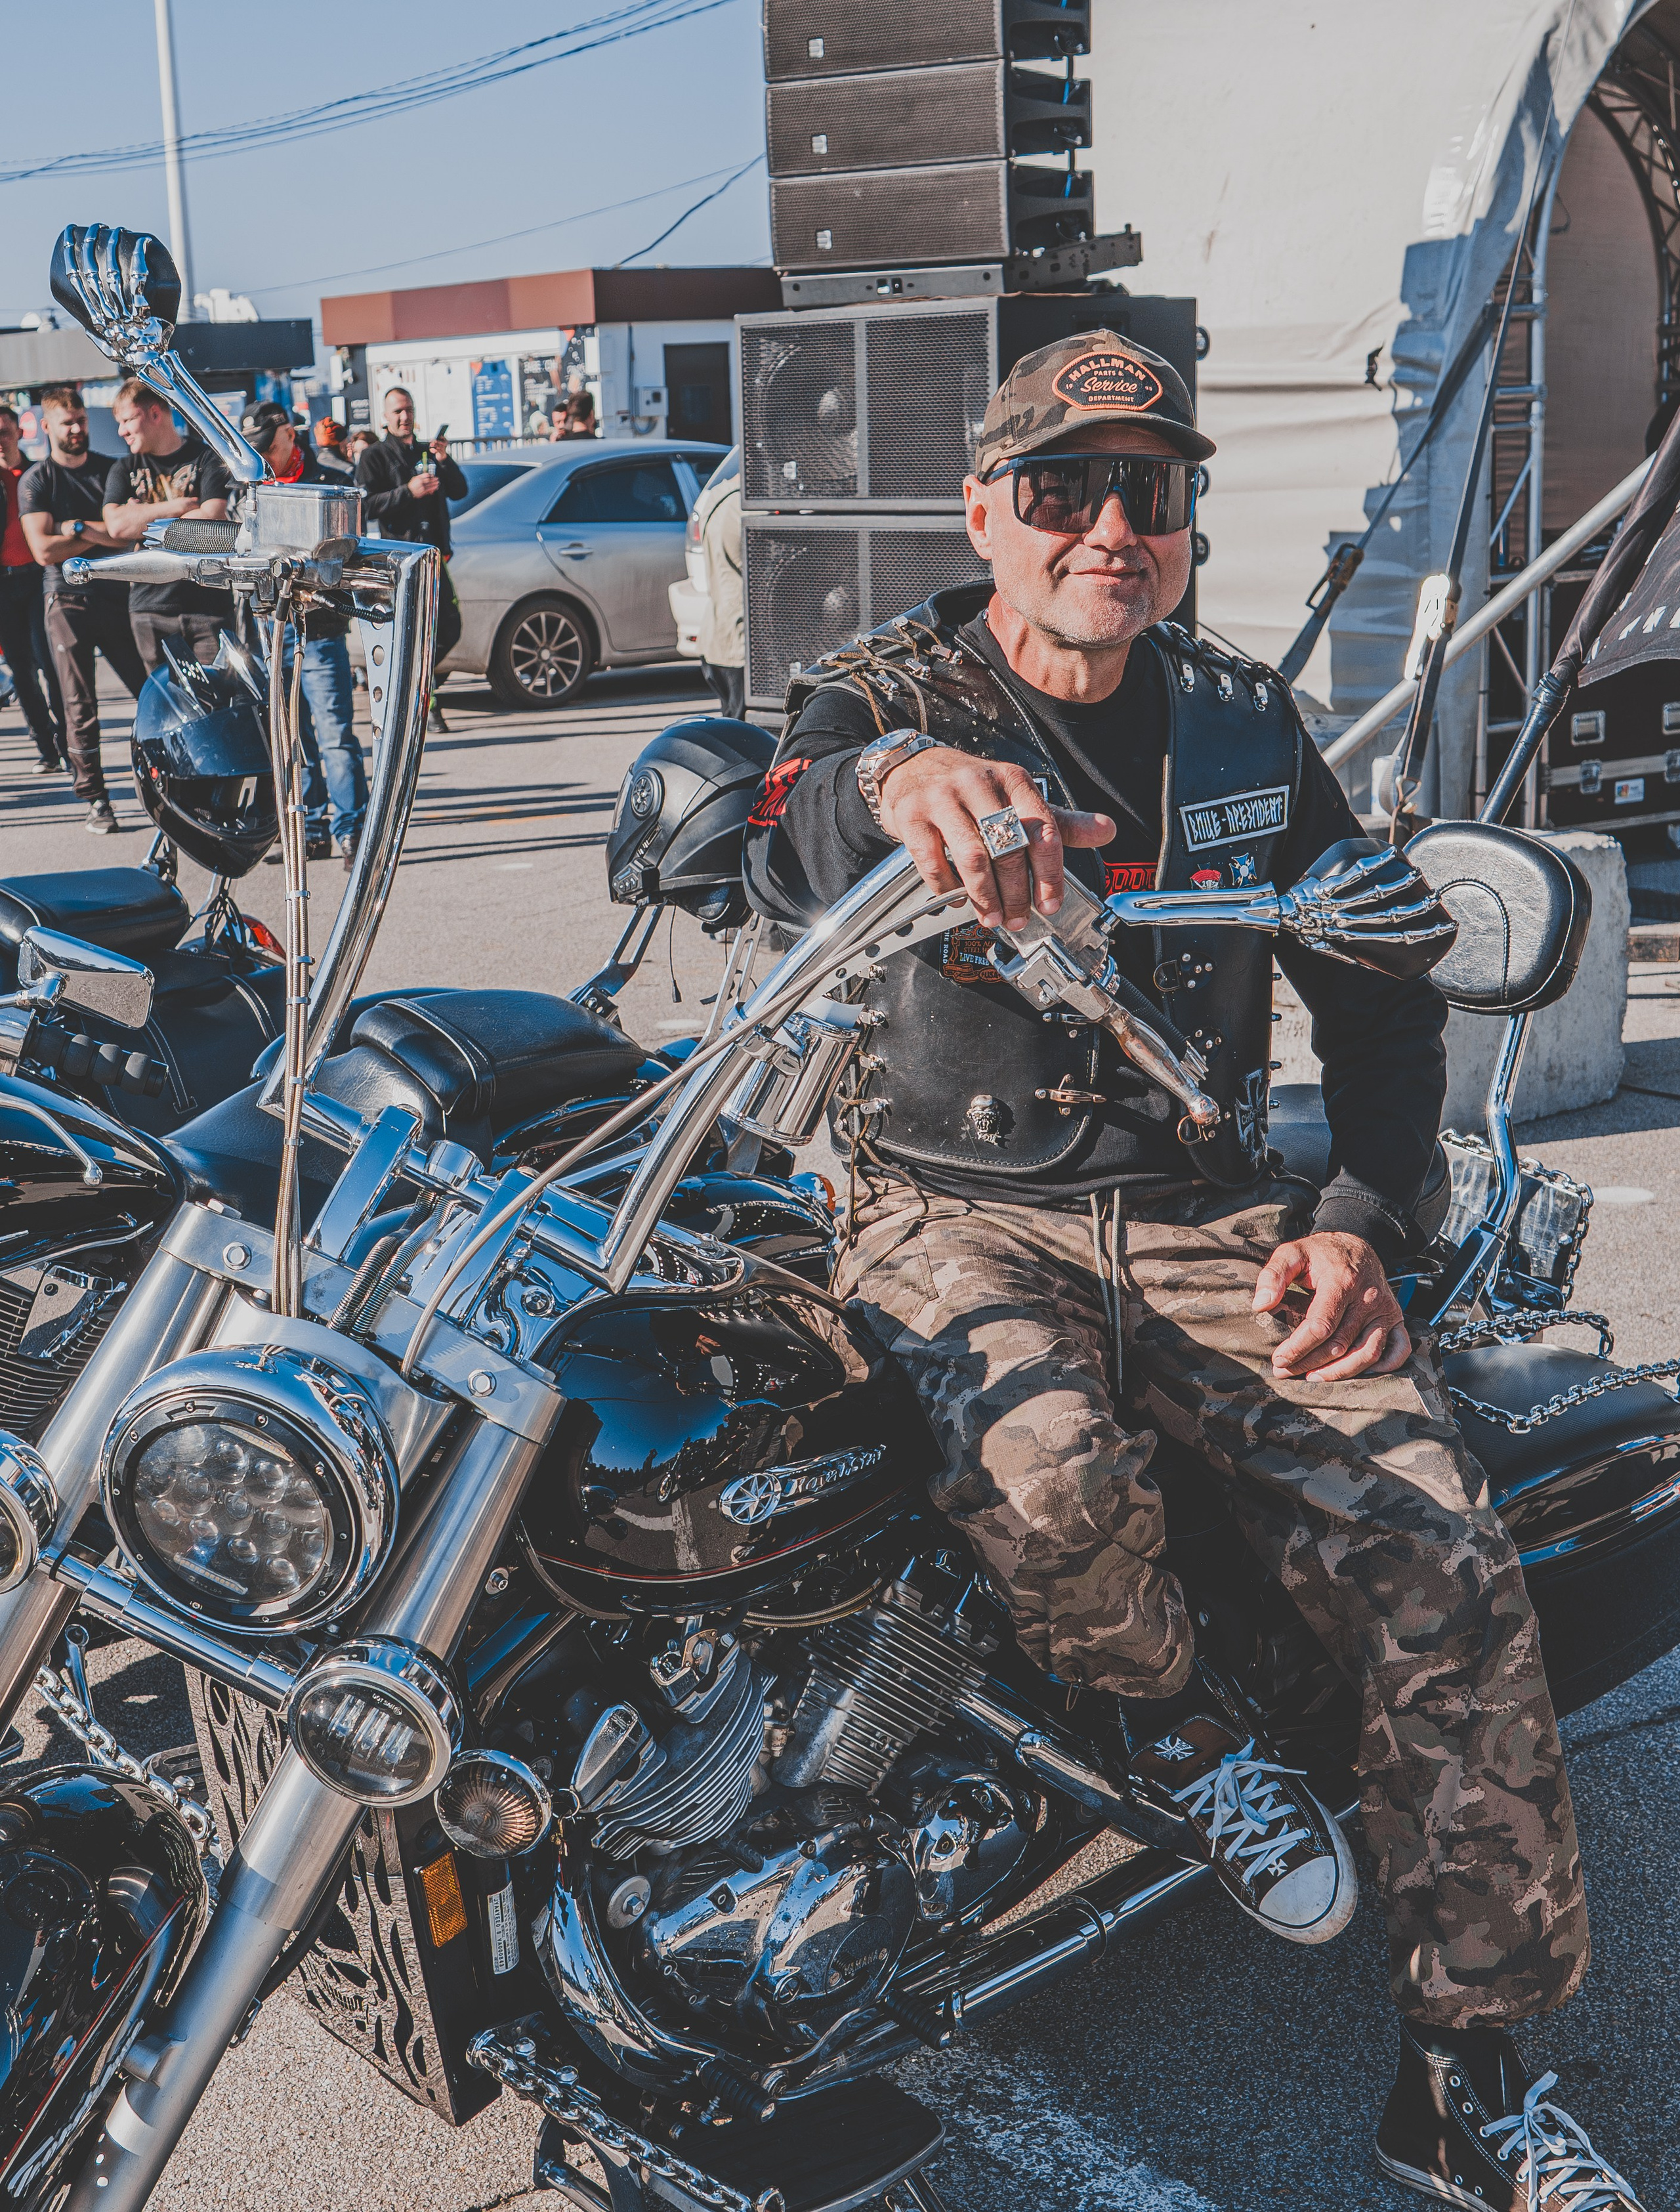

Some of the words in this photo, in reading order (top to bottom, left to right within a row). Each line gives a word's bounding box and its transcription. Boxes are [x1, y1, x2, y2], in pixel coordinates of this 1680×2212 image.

[1068, 358, 1146, 381] HALLMAN
[1080, 377, 1138, 393] Service
[959, 952, 974, 963] LIVE
[844, 1949, 878, 1976] YAMAHA
